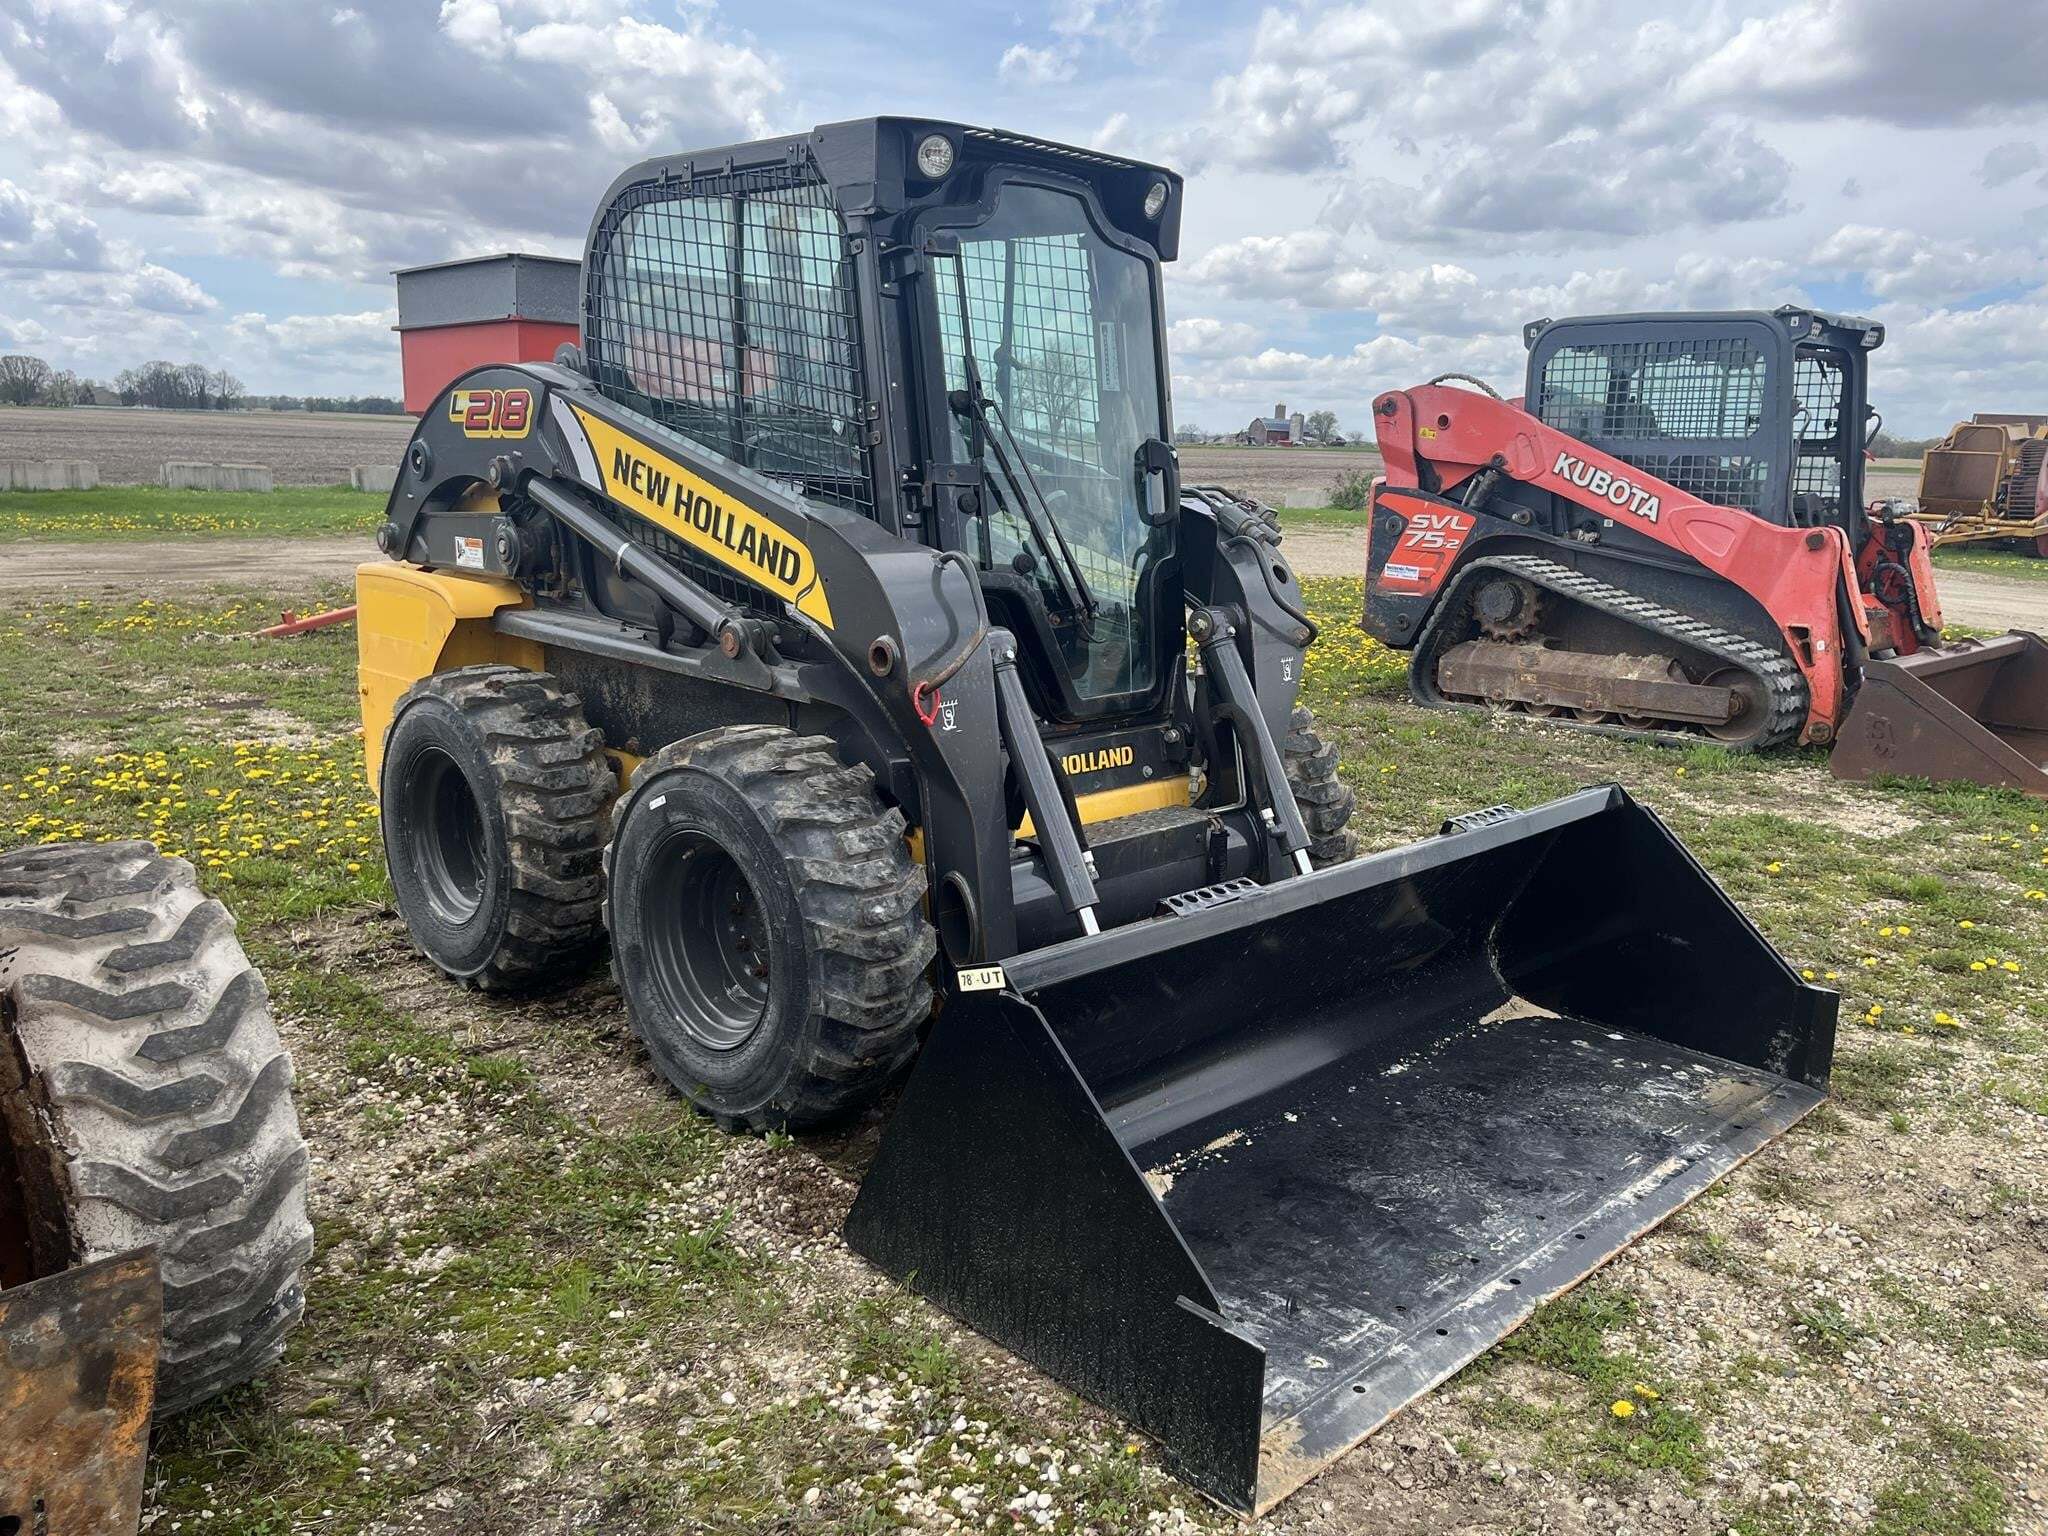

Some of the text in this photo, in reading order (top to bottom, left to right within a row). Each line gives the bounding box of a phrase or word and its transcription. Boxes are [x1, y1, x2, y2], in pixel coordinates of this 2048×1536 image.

[613, 448, 801, 586] NEW HOLLAND
[1408, 514, 1469, 531] SVL
[1552, 451, 1661, 524] KUBOTA
